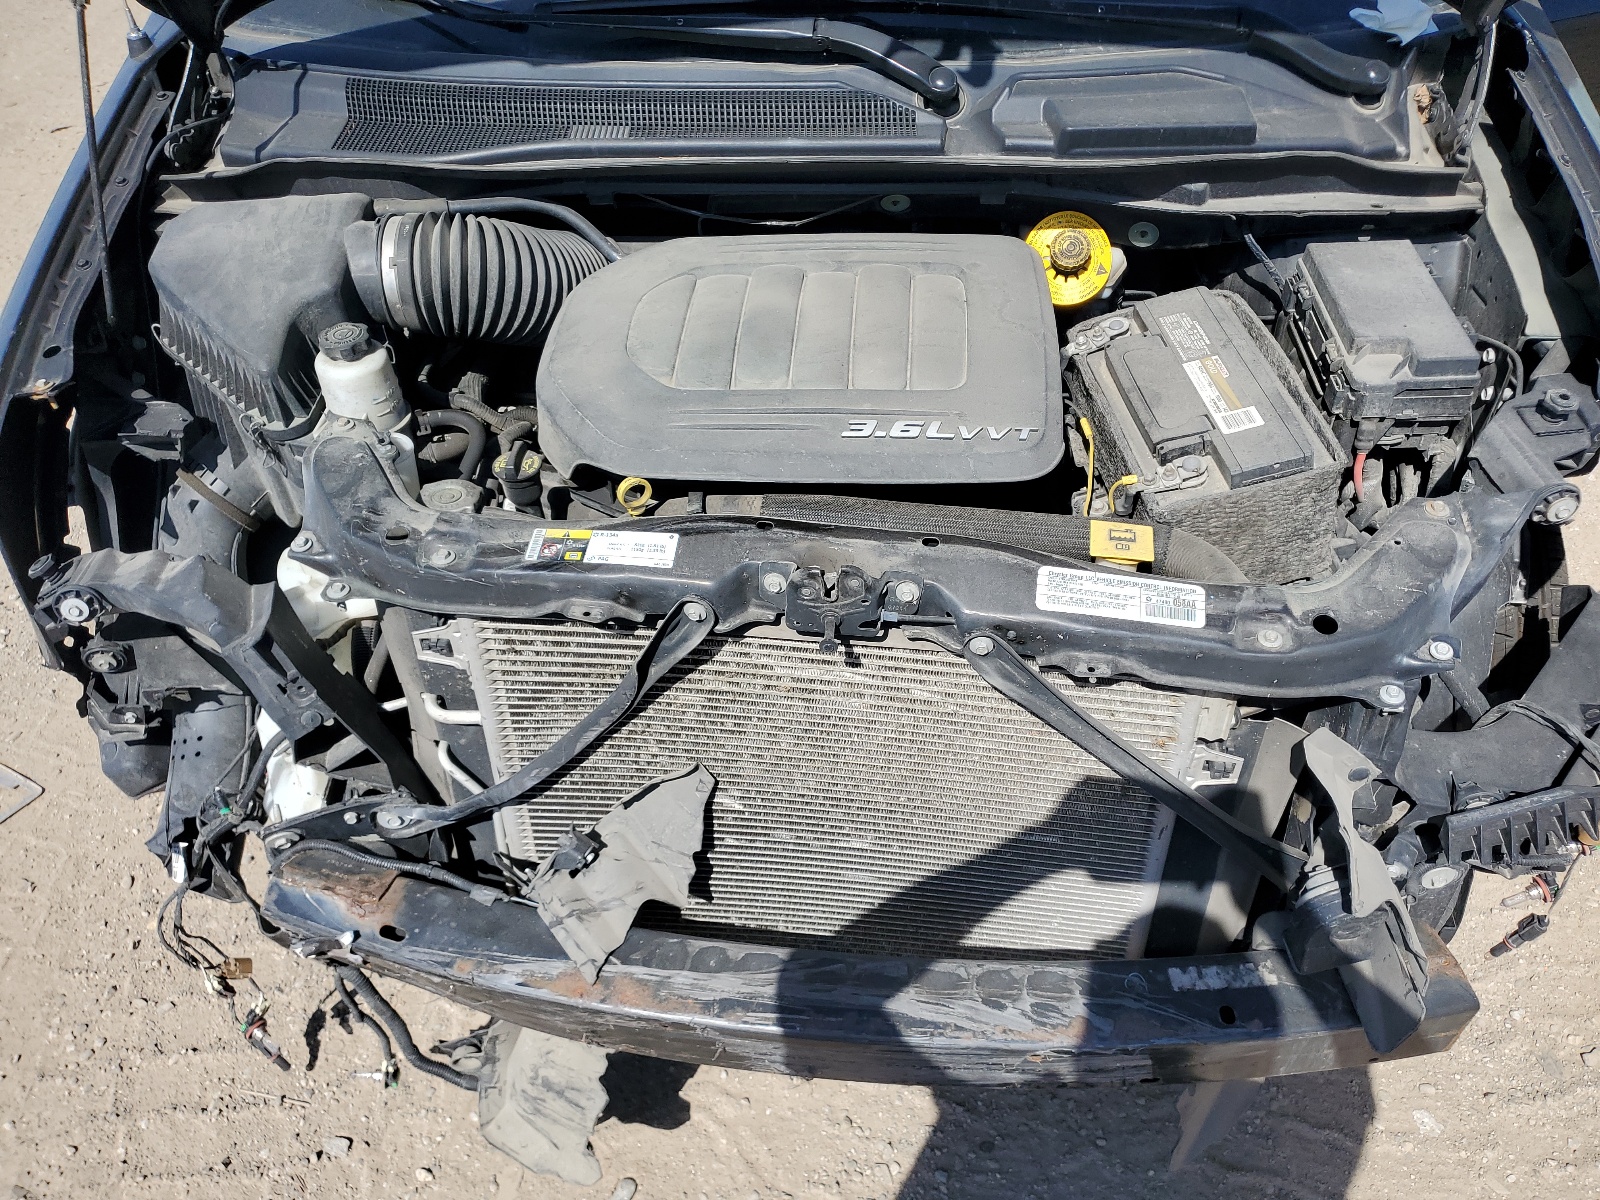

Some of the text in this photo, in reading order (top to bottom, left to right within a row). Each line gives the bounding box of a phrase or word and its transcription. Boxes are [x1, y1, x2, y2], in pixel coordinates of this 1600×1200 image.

[1205, 360, 1218, 374] GOLD
[841, 420, 1039, 441] 3.6L VVT
[1163, 585, 1197, 594] INFORMATION
